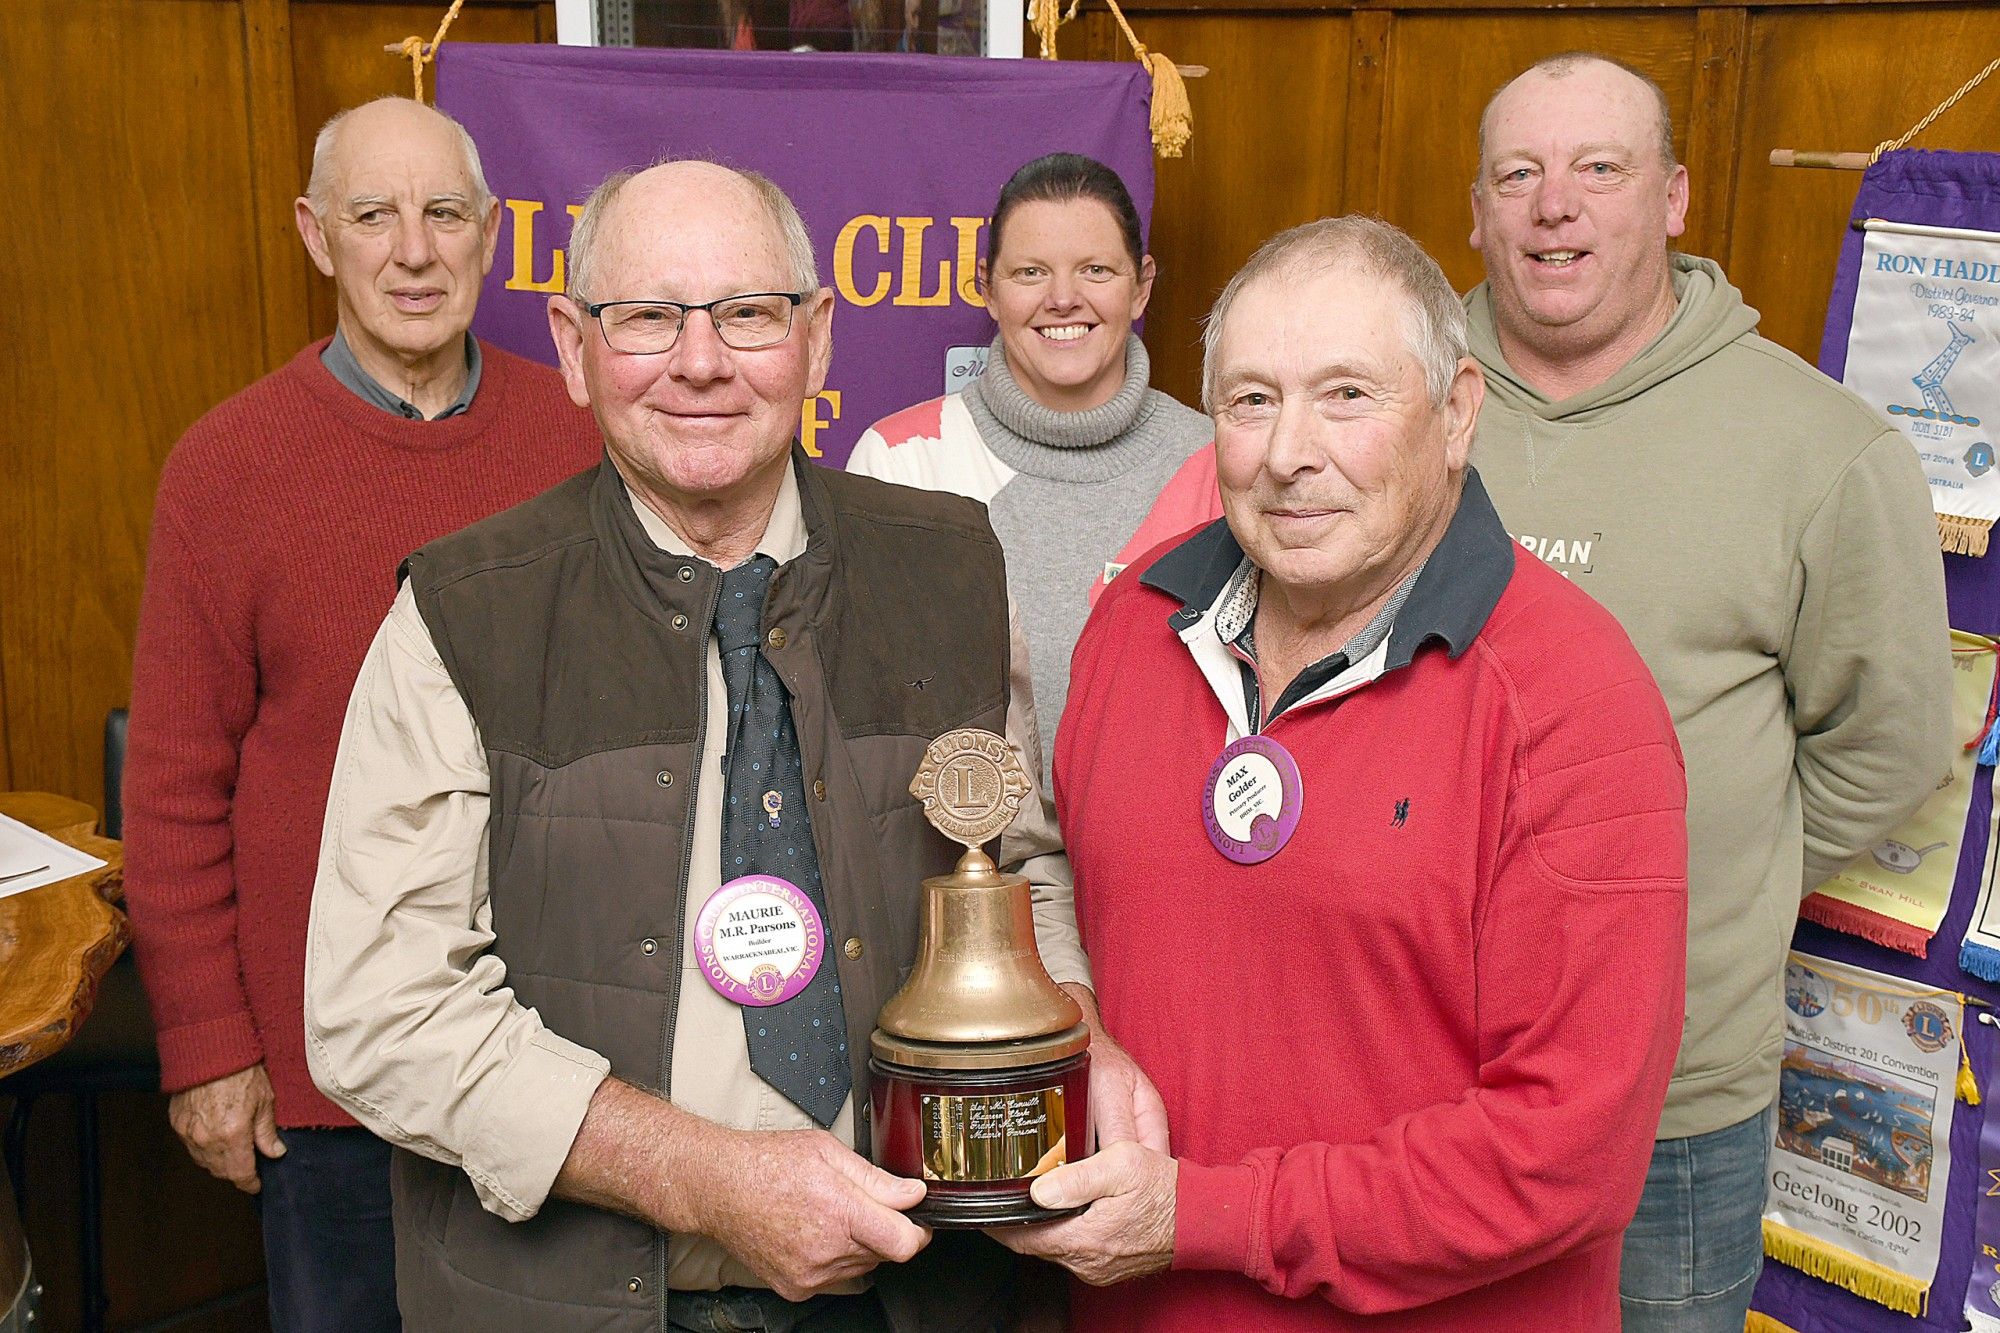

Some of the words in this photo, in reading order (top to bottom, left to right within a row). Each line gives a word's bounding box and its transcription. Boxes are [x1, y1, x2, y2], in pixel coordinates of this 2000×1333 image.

[832, 214, 992, 307] CLU
[1876, 253, 1927, 275] RON
[1910, 282, 1954, 301] District
[1954, 287, 1999, 306] Governor
[1927, 303, 1975, 322] 1983-84
[801, 390, 841, 457] F
[1933, 425, 1954, 437] SIBI
[1975, 453, 1984, 466] L
[1928, 477, 1964, 489] USTRALIA
[934, 732, 1002, 757] LIONS
[953, 766, 988, 808] L
[1226, 765, 1249, 788] MAX
[1205, 765, 1220, 820] CLUBS
[1228, 776, 1257, 802] Golder
[1211, 822, 1246, 855] LIONS
[1860, 880, 1894, 897] SWAN
[1899, 893, 1925, 909] HILL
[729, 906, 784, 922] MAURIE
[720, 926, 748, 939] M.R.
[750, 921, 796, 935] Parsons
[748, 938, 772, 946] Builder
[702, 944, 738, 993] LIONS
[761, 976, 773, 991] L
[1831, 986, 1899, 1024] 50th
[1921, 1016, 1935, 1037] L
[1787, 1024, 1821, 1043] Multiple
[1823, 1036, 1857, 1056] District
[1860, 1046, 1878, 1062] 201
[1881, 1055, 1939, 1081] Convention
[1772, 1170, 1860, 1224] Geelong
[1867, 1204, 1922, 1243] 2002
